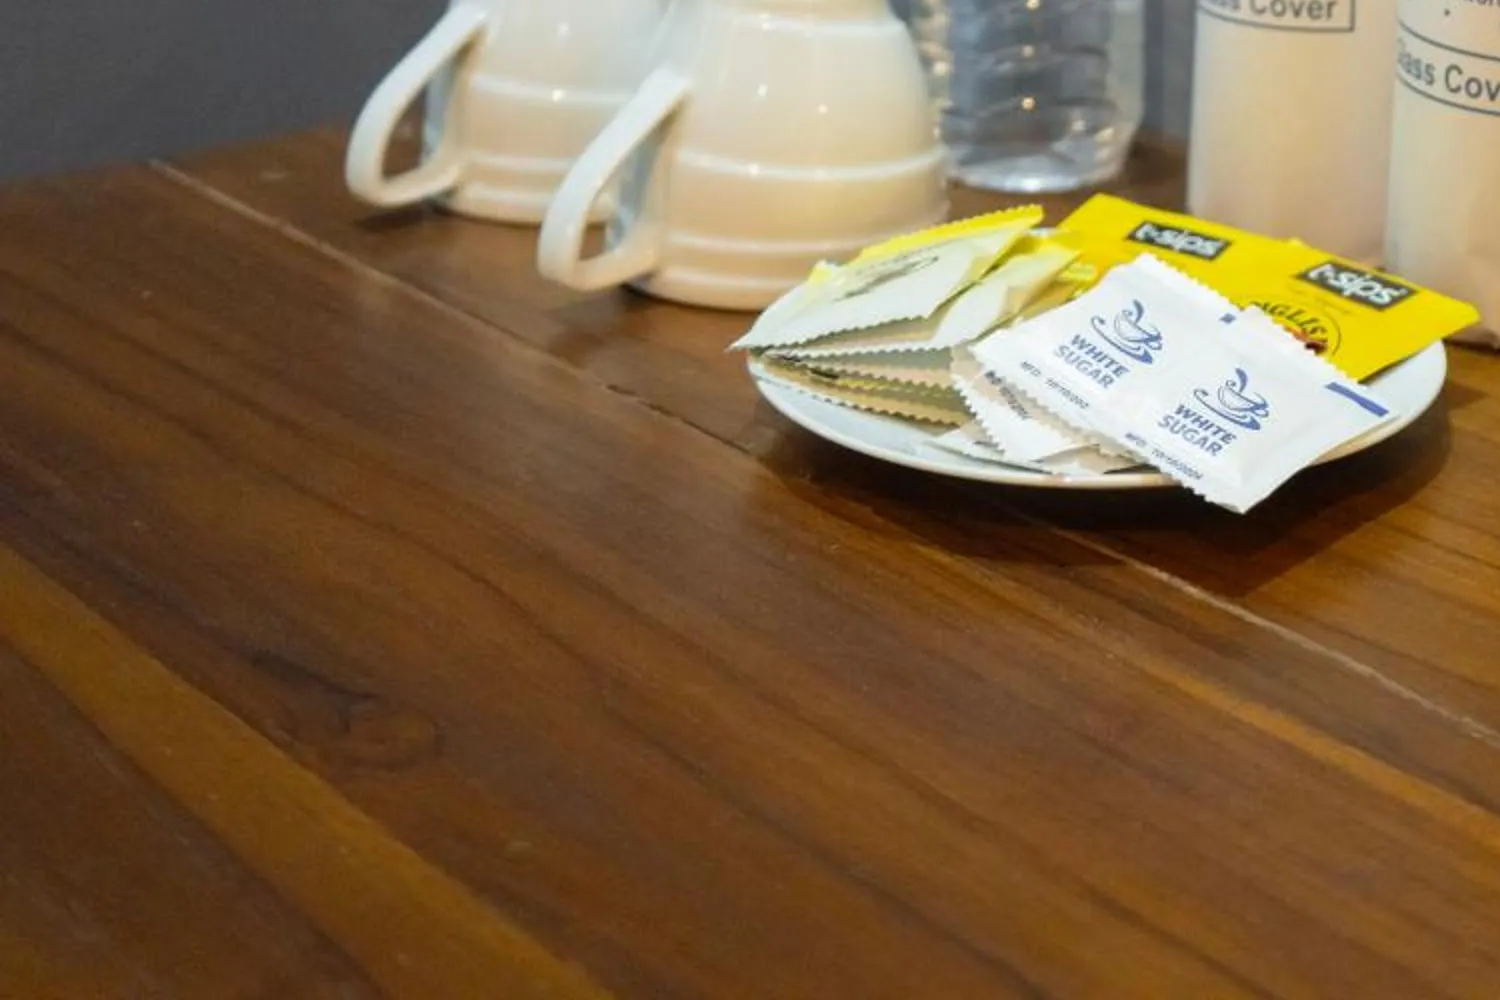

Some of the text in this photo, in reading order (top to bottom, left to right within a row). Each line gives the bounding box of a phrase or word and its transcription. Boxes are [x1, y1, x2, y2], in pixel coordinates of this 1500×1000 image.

[1307, 262, 1397, 306] t-sips
[1054, 345, 1116, 389] SUGAR
[1071, 333, 1131, 378] WHITE
[1157, 415, 1224, 457] SUGAR
[1174, 404, 1238, 446] WHITE
